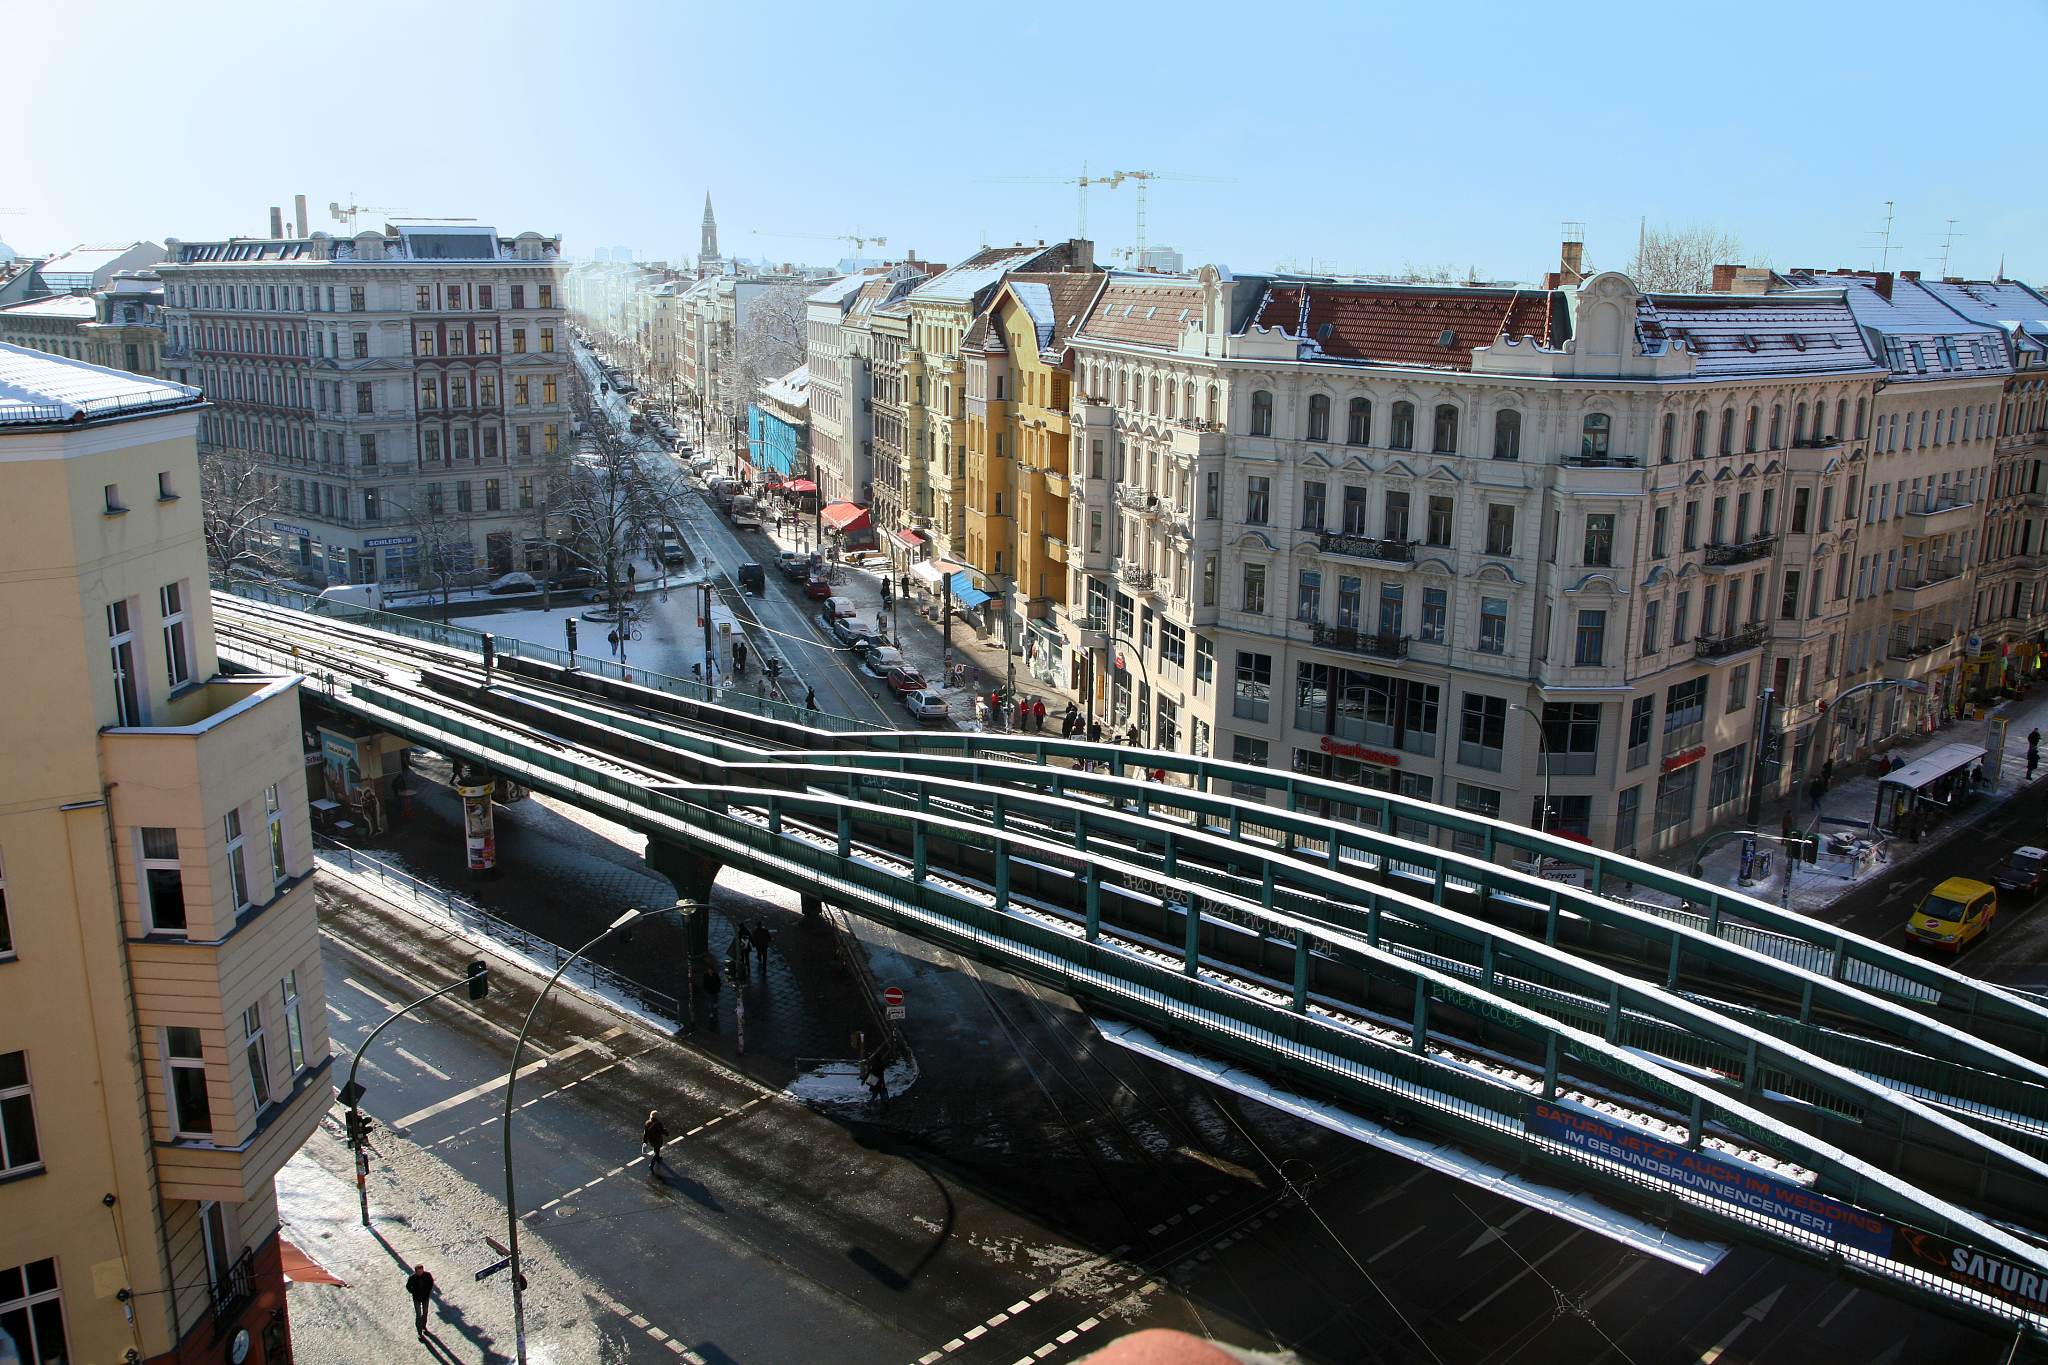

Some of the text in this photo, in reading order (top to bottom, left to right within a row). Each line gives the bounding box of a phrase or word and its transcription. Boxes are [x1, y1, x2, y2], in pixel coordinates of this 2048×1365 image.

[368, 537, 413, 547] SCHLECKER
[1320, 736, 1400, 767] Sparkasse
[1661, 745, 1707, 774] Sparkasse
[1544, 872, 1578, 882] Crêpes
[1535, 1104, 1613, 1141] SATURN
[1617, 1132, 1678, 1163] JETZT
[1680, 1155, 1741, 1186] AUCH
[1745, 1177, 1770, 1196] IM
[1565, 1129, 1833, 1234] IM GESUNDBRUNNENCENTER!
[1949, 1270, 1984, 1290] GEIZ
[1988, 1287, 2012, 1302] IST
